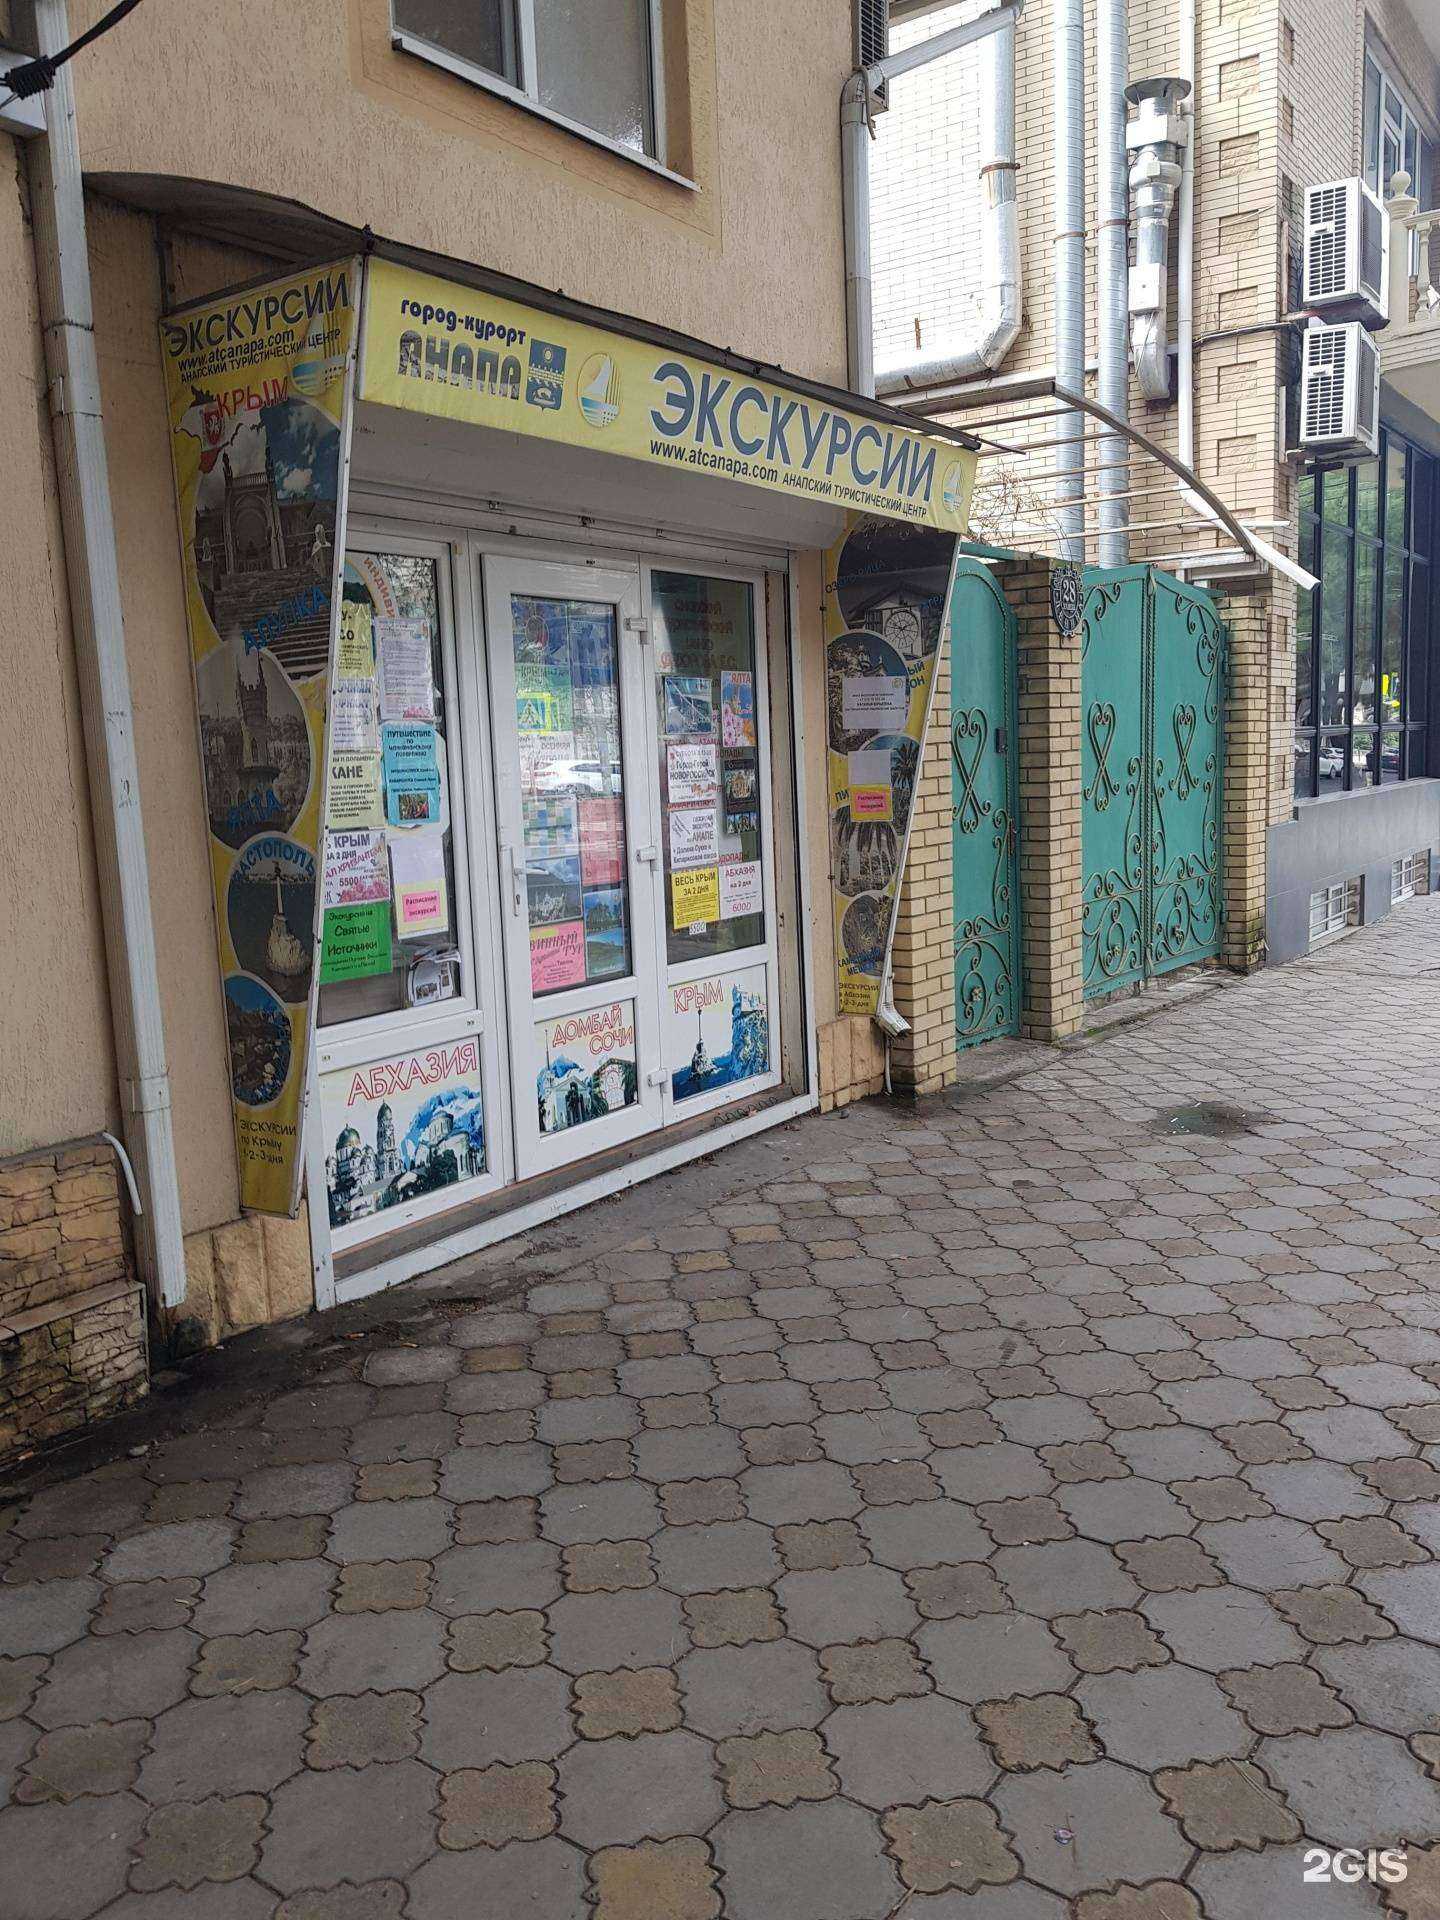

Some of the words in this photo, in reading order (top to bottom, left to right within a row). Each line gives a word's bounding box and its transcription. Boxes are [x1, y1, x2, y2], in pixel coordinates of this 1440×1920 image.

[164, 271, 349, 358] ЭКСКУРСИИ
[400, 296, 525, 346] город-курорт
[178, 329, 294, 372] www.atcanapa.com
[308, 328, 341, 350] ЦЕНТР
[398, 330, 520, 401] АНАПА
[215, 376, 290, 420] КРЫМ
[650, 362, 938, 501] ЭКСКУРСИИ
[650, 440, 778, 483] www.atcanapa.com
[782, 472, 833, 497] АНАПСКИЙ
[833, 483, 902, 514] ТУРИСТИЧЕСКИЙ
[902, 501, 928, 519] ЦЕНТР
[1063, 580, 1076, 603] 28
[334, 834, 370, 849] КРЫМ
[342, 850, 356, 861] ДНЯ
[675, 874, 694, 886] ВЕСЬ
[695, 871, 716, 883] КРЫМ
[725, 866, 756, 878] АБХАЗИЯ
[683, 888, 692, 896] ЗА
[673, 979, 723, 1014] КРЫМ
[552, 1003, 624, 1049] ДОМБАЙ
[589, 1026, 634, 1056] СОЧИ
[347, 1042, 478, 1107] АБХАЗИЯ
[239, 1119, 296, 1136] ЭКСКУРСИИ
